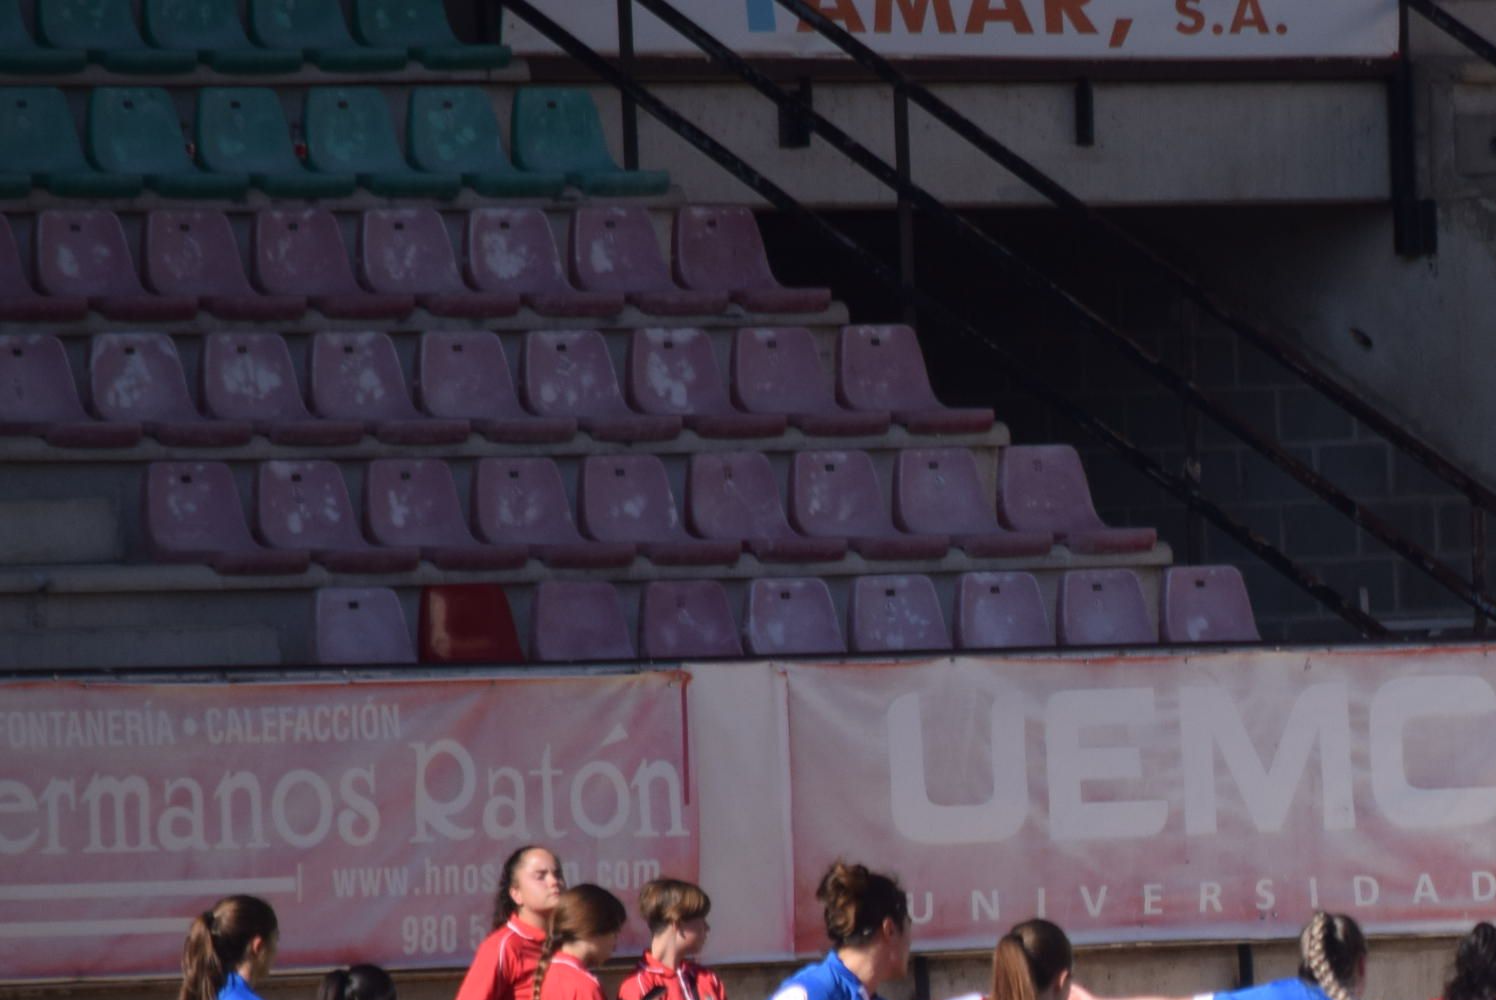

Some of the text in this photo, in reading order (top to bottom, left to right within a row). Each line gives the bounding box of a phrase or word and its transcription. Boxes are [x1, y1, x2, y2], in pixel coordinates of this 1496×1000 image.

[1176, 0, 1288, 36] S.A.
[205, 695, 401, 745] CALEFACCIÓN
[409, 724, 690, 845] Ratón
[403, 914, 457, 954] 980
